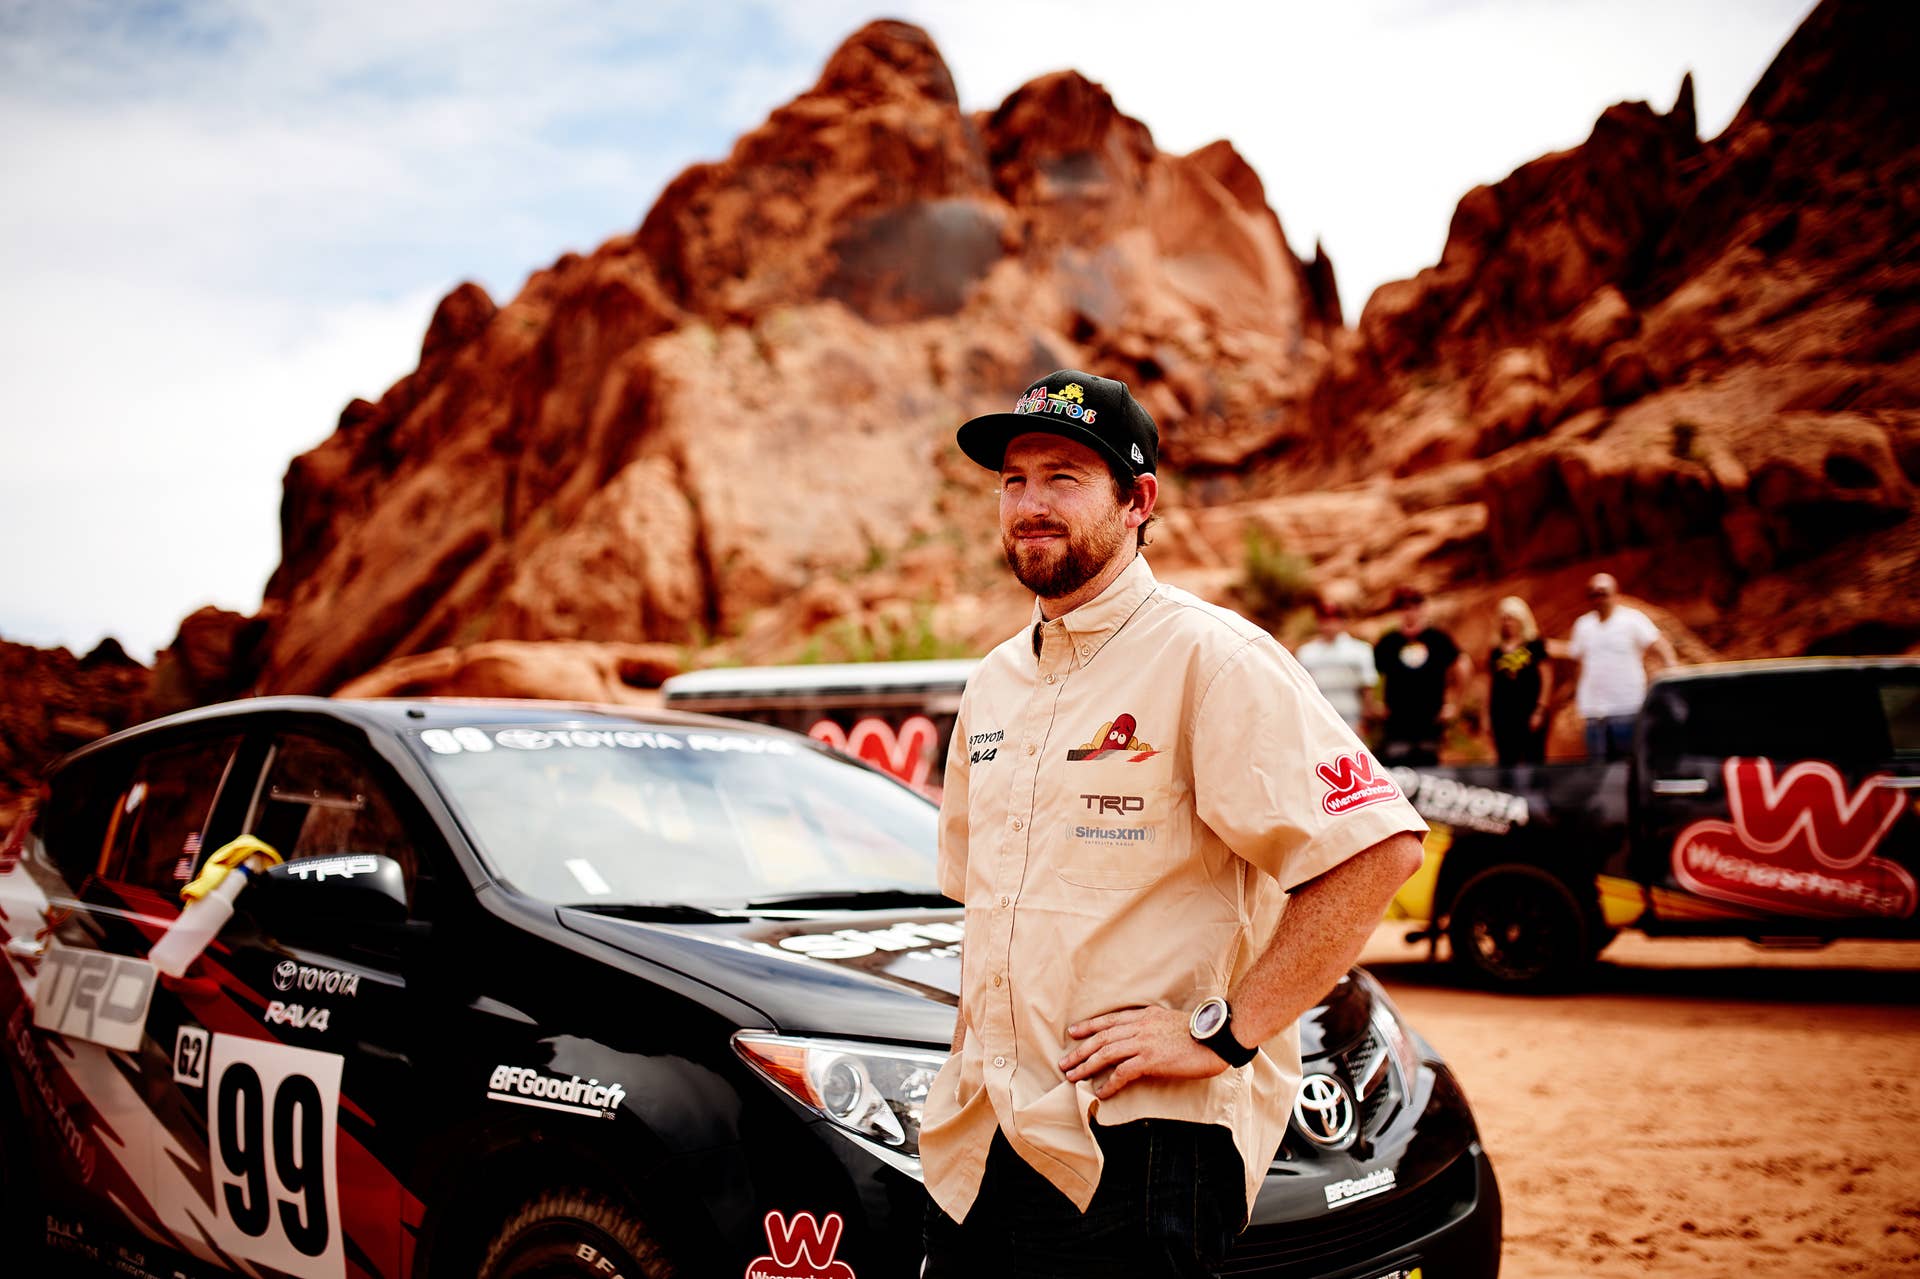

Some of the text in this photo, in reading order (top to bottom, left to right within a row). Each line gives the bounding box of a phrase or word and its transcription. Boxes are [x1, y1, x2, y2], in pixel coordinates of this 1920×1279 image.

[548, 730, 683, 750] TOYOTA
[973, 729, 1004, 746] TOYOTA
[1316, 751, 1375, 792] W
[1080, 794, 1144, 816] TRD
[1418, 774, 1529, 826] TOYOTA
[1724, 755, 1906, 869] W
[297, 966, 360, 997] TOYOTA
[264, 1000, 331, 1032] RAV4
[488, 1065, 626, 1110] BFGoodrich
[218, 1062, 330, 1257] 99
[1324, 1167, 1396, 1203] BFGoodrich
[764, 1210, 843, 1270] W
